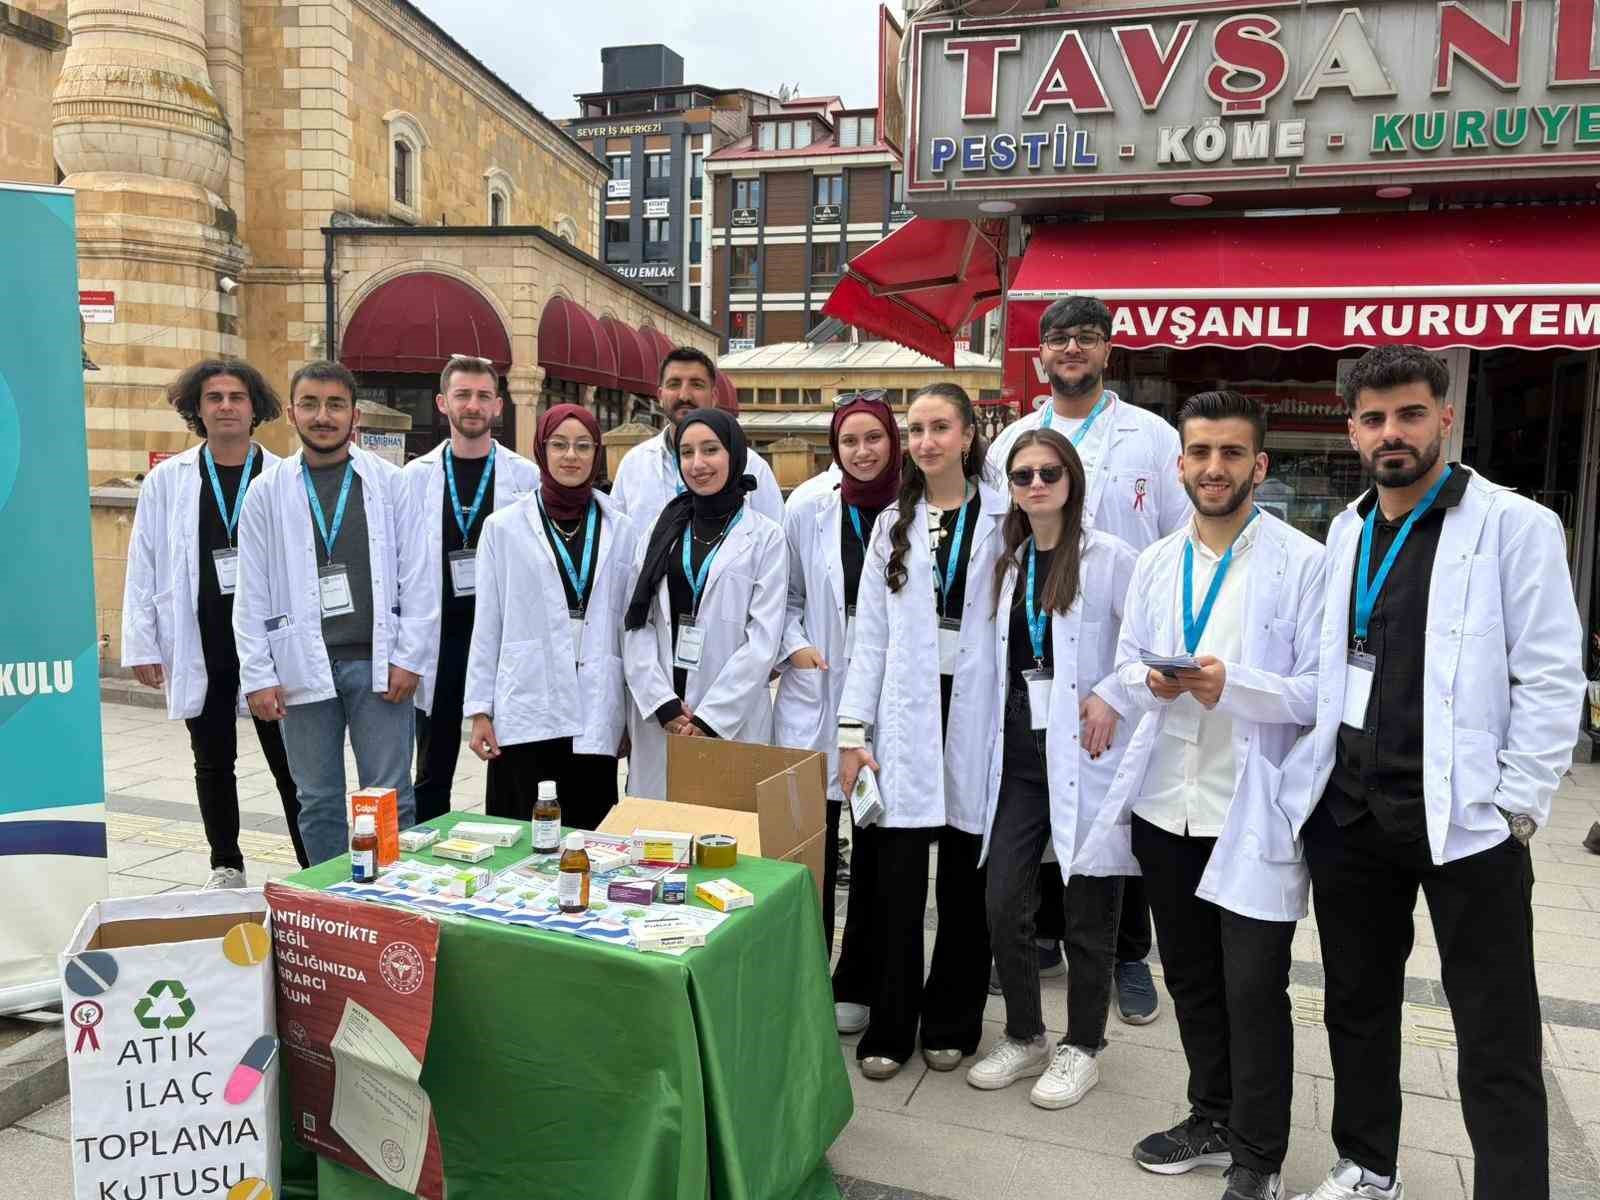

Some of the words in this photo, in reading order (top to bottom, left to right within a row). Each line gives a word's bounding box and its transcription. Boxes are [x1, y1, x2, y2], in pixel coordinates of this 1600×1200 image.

[577, 127, 606, 137] SEVER
[620, 122, 662, 135] MERKEZİ
[930, 123, 1098, 172] PESTİL
[1157, 116, 1306, 164] KÖME
[1369, 103, 1600, 155] KURUYE
[638, 266, 677, 278] EMLAK
[1106, 305, 1310, 344] AVŞANLI
[1343, 303, 1600, 336] KURUYEM
[0, 660, 73, 697] KULU
[117, 1031, 208, 1066] ATIK
[125, 1071, 213, 1112] İLAÇ
[76, 1117, 260, 1163] TOPLAMA
[99, 1161, 246, 1200] KUTUSU
